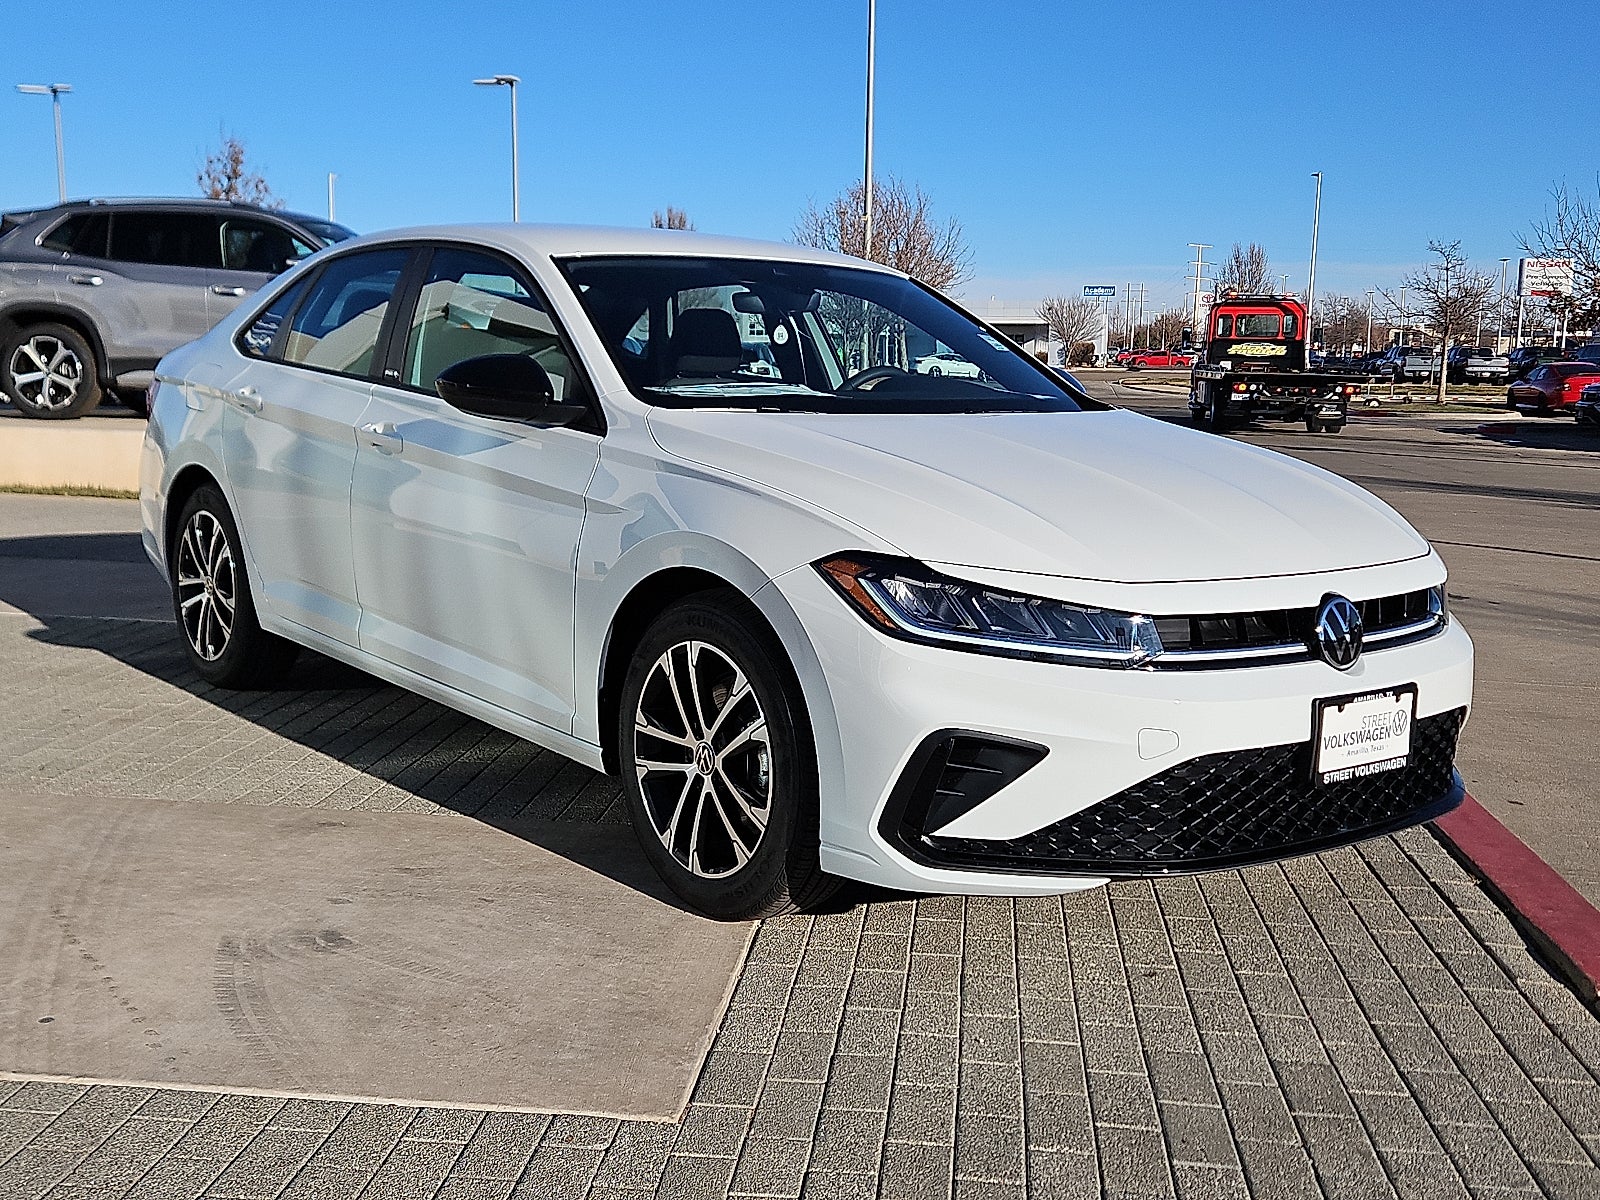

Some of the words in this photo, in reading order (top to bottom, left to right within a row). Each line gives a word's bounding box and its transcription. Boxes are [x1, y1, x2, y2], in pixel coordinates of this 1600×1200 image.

[1085, 286, 1115, 295] Academy
[1361, 711, 1392, 730] STREET
[1323, 725, 1392, 750] VOLKSWAGEN
[1323, 768, 1354, 785] STREET
[1354, 757, 1407, 777] VOLKSWAGEN
